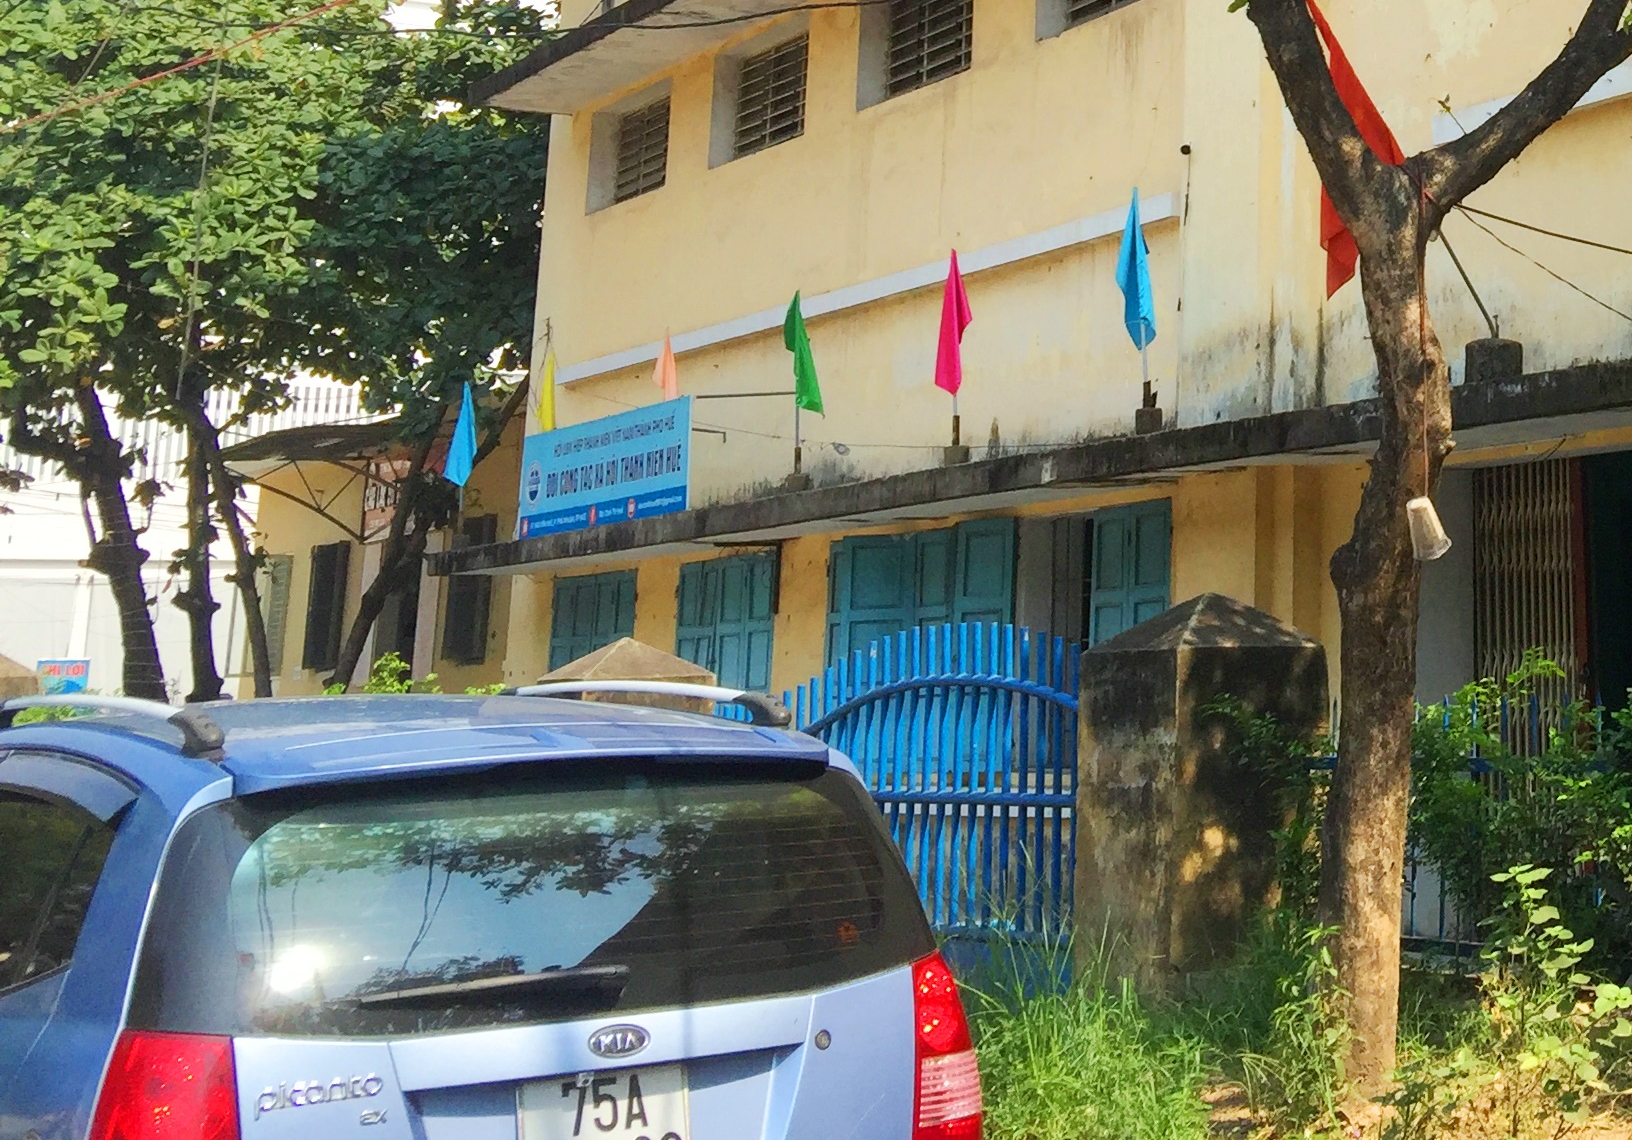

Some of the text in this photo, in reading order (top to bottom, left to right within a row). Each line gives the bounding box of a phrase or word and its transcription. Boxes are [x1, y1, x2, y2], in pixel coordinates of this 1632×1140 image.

[599, 1032, 642, 1053] KIA
[254, 1071, 384, 1122] picanto
[561, 1073, 649, 1137] 75A
